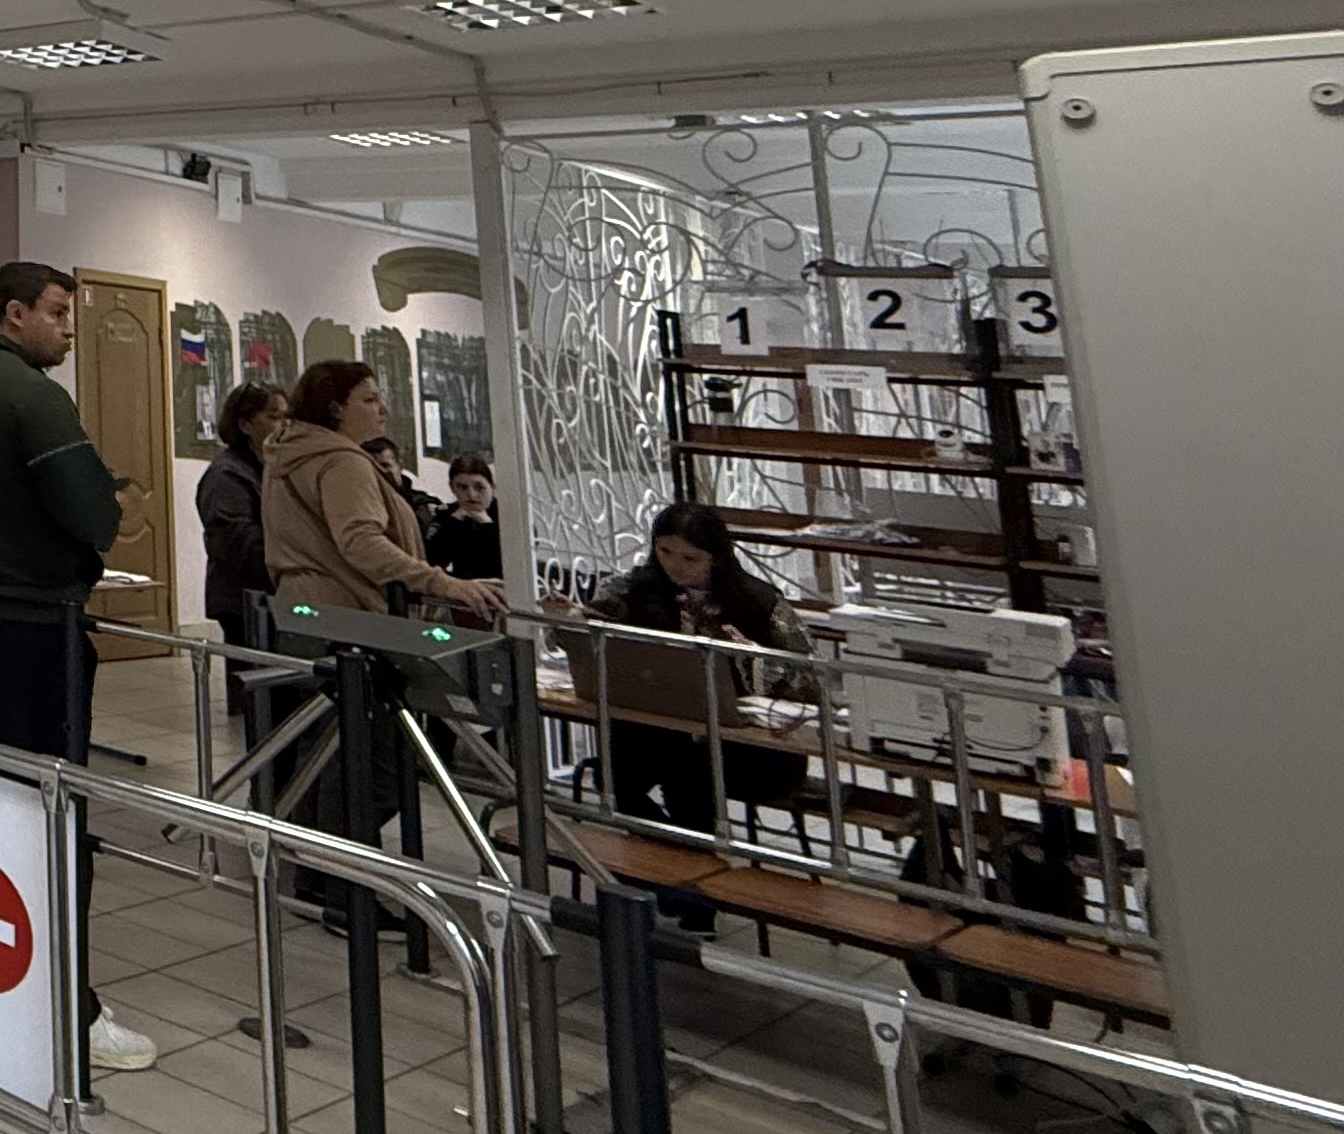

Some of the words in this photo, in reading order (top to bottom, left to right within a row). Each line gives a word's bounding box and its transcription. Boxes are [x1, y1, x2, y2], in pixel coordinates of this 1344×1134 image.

[726, 306, 751, 345] 1
[866, 289, 906, 330] 2
[1018, 290, 1058, 334] 3
